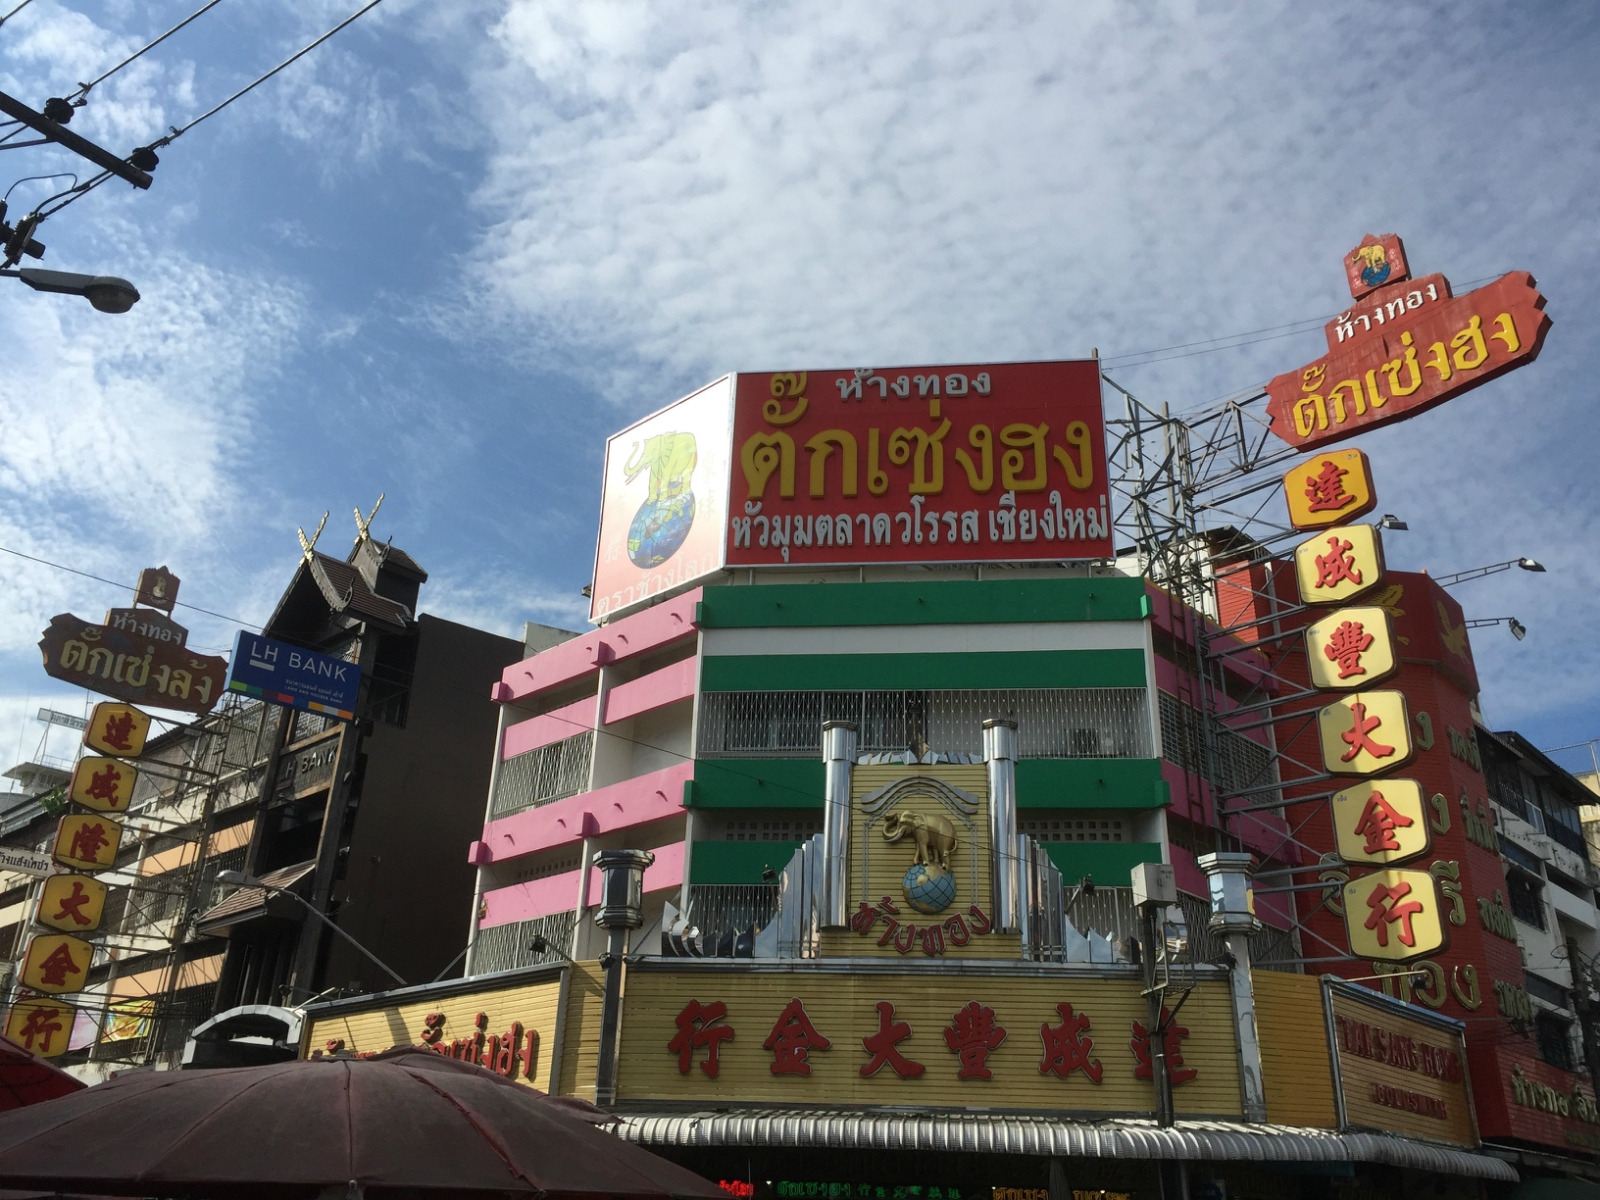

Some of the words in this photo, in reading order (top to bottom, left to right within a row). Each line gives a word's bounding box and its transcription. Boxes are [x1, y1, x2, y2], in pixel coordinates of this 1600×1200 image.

[1335, 283, 1439, 343] ห้างทอง
[836, 367, 991, 400] ห้างทอง
[1292, 313, 1521, 437] ตั๊กเซ่งฮง
[740, 371, 1094, 498] ตั๊กเซ่งฮง
[989, 490, 1109, 541] เชียงใหม่
[111, 612, 183, 645] ห้างทอง
[59, 626, 213, 705] ตั๊กเซ่งล้ง
[251, 641, 278, 662] LH
[288, 652, 347, 682] BANK
